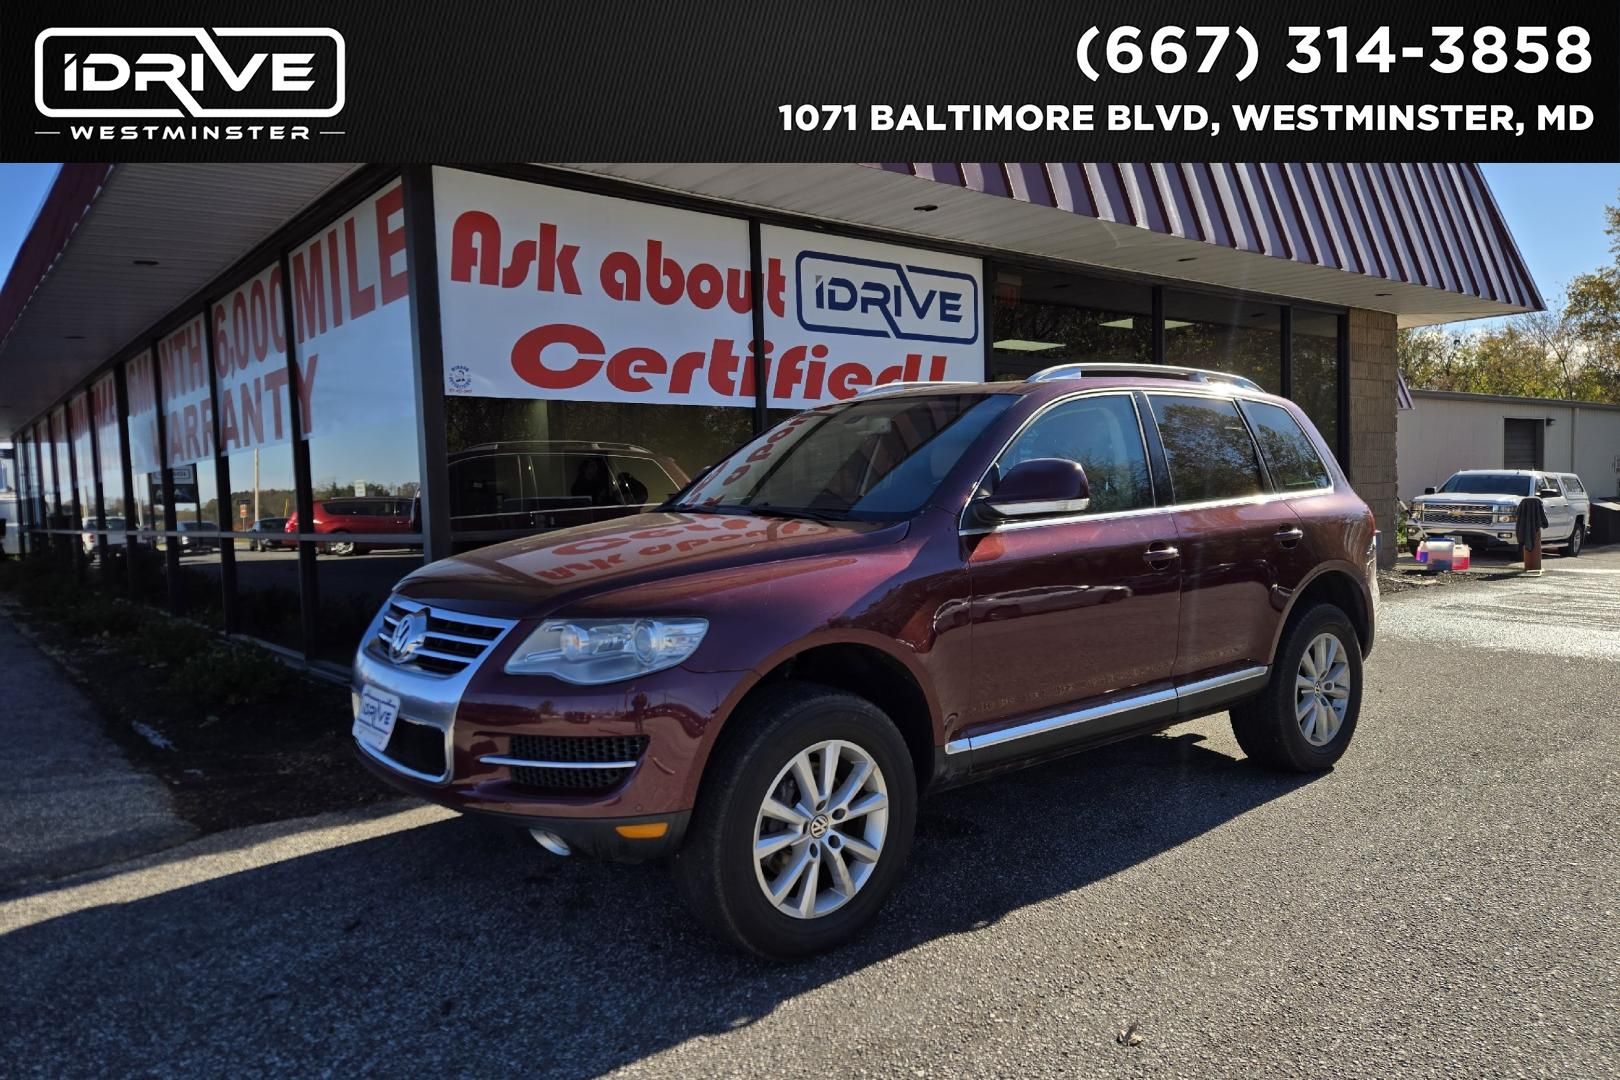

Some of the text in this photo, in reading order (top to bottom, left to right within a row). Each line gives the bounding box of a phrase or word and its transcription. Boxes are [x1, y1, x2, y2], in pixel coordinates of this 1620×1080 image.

[291, 184, 410, 344] MILE
[450, 210, 582, 295] Ask
[600, 239, 786, 318] about
